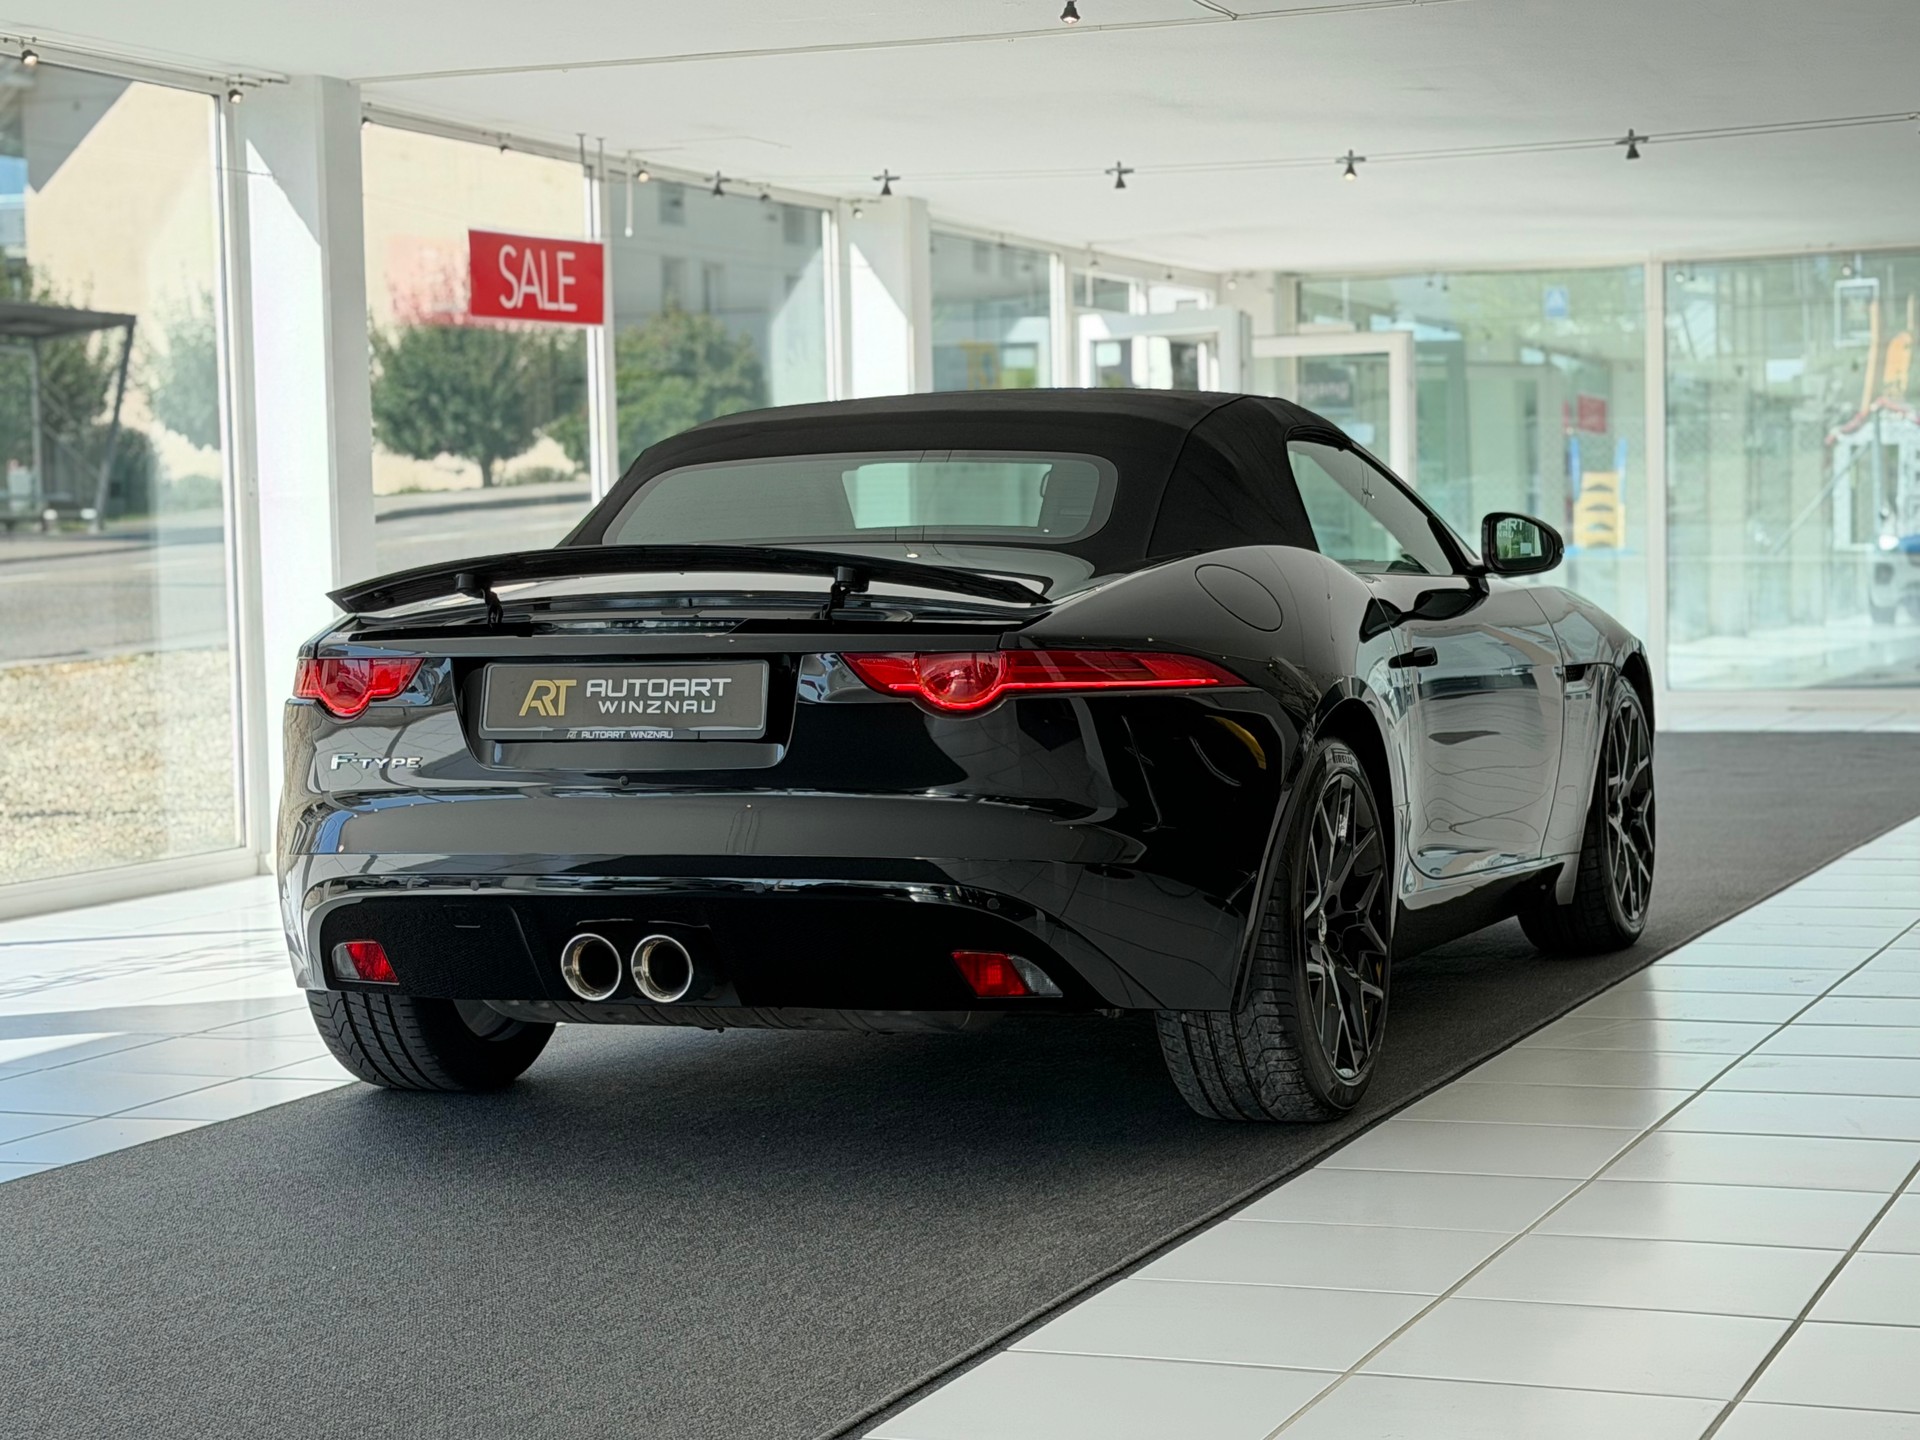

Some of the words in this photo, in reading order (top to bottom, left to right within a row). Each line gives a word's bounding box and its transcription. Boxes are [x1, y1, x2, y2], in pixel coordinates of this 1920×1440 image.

[498, 244, 578, 312] SALE
[586, 678, 732, 697] AUTOART
[598, 699, 716, 714] WINZNAU
[581, 730, 626, 739] AUTOART
[630, 730, 674, 739] WINZNAU
[330, 752, 423, 770] F-TYPE
